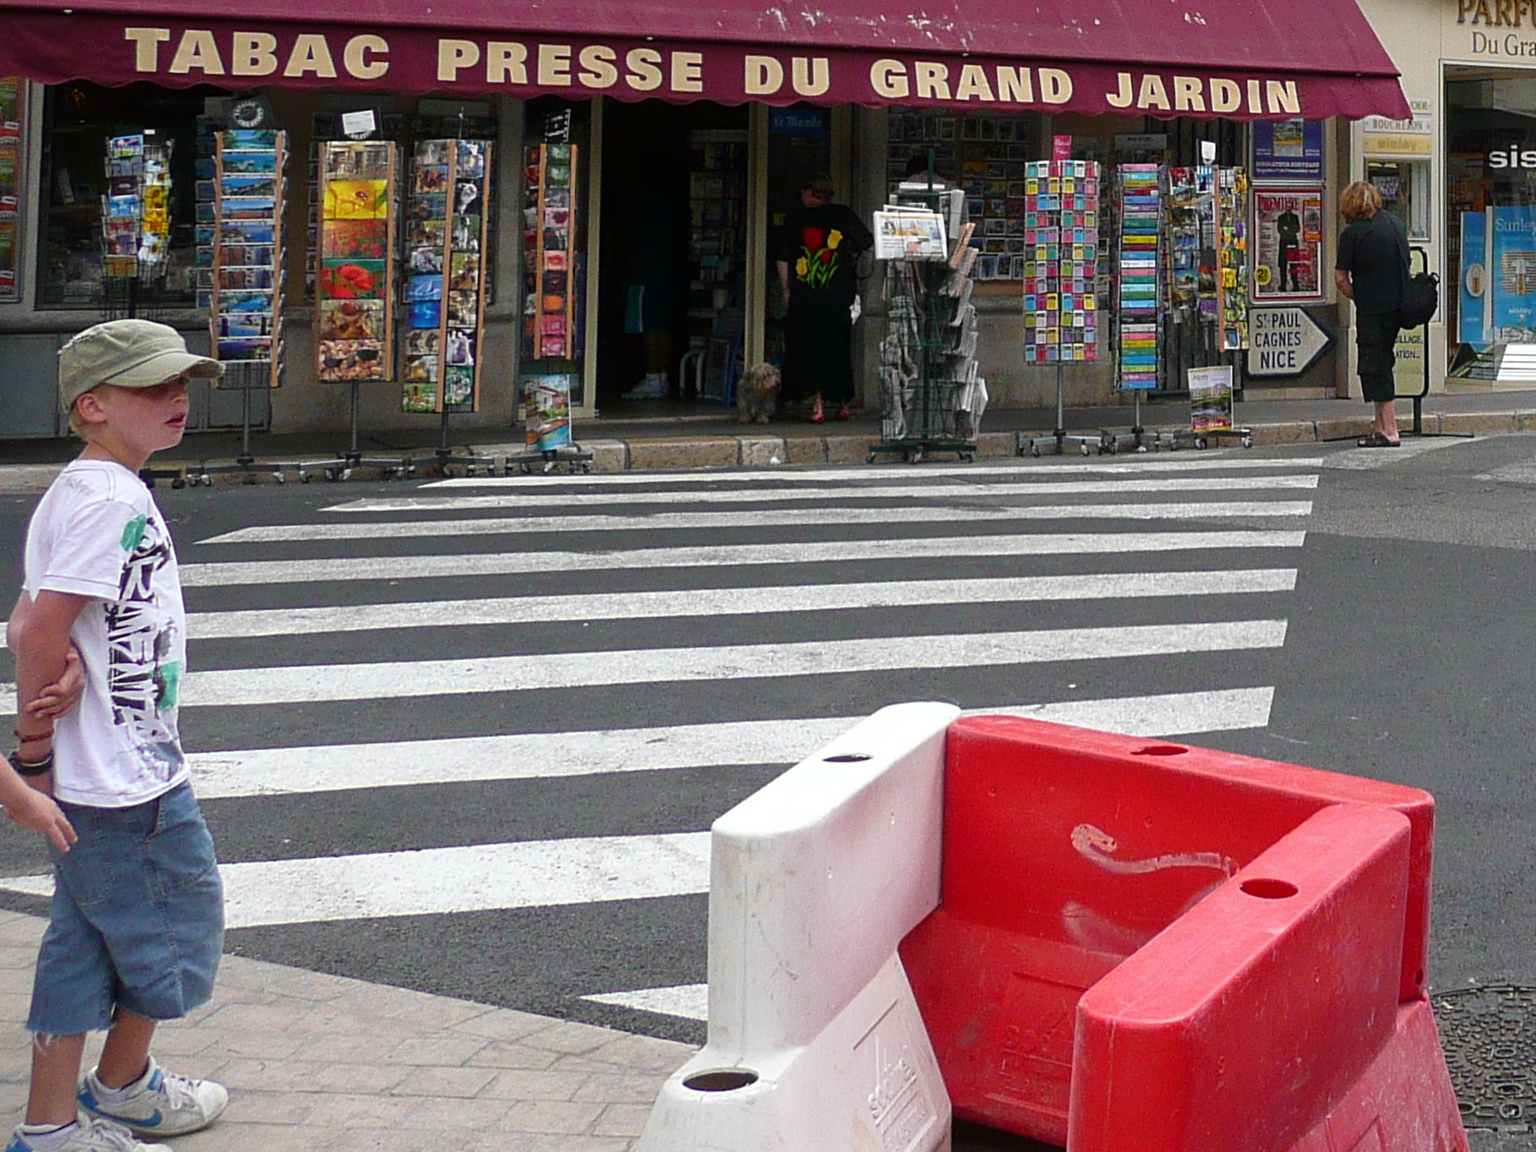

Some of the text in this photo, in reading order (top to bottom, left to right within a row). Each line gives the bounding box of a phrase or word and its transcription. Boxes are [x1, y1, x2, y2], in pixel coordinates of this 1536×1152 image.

[1472, 31, 1499, 55] Du
[125, 27, 1301, 114] TABAC PRESSE DU GRAND JARDIN
[1255, 331, 1302, 347] CAGNES
[1260, 350, 1296, 368] NICE
